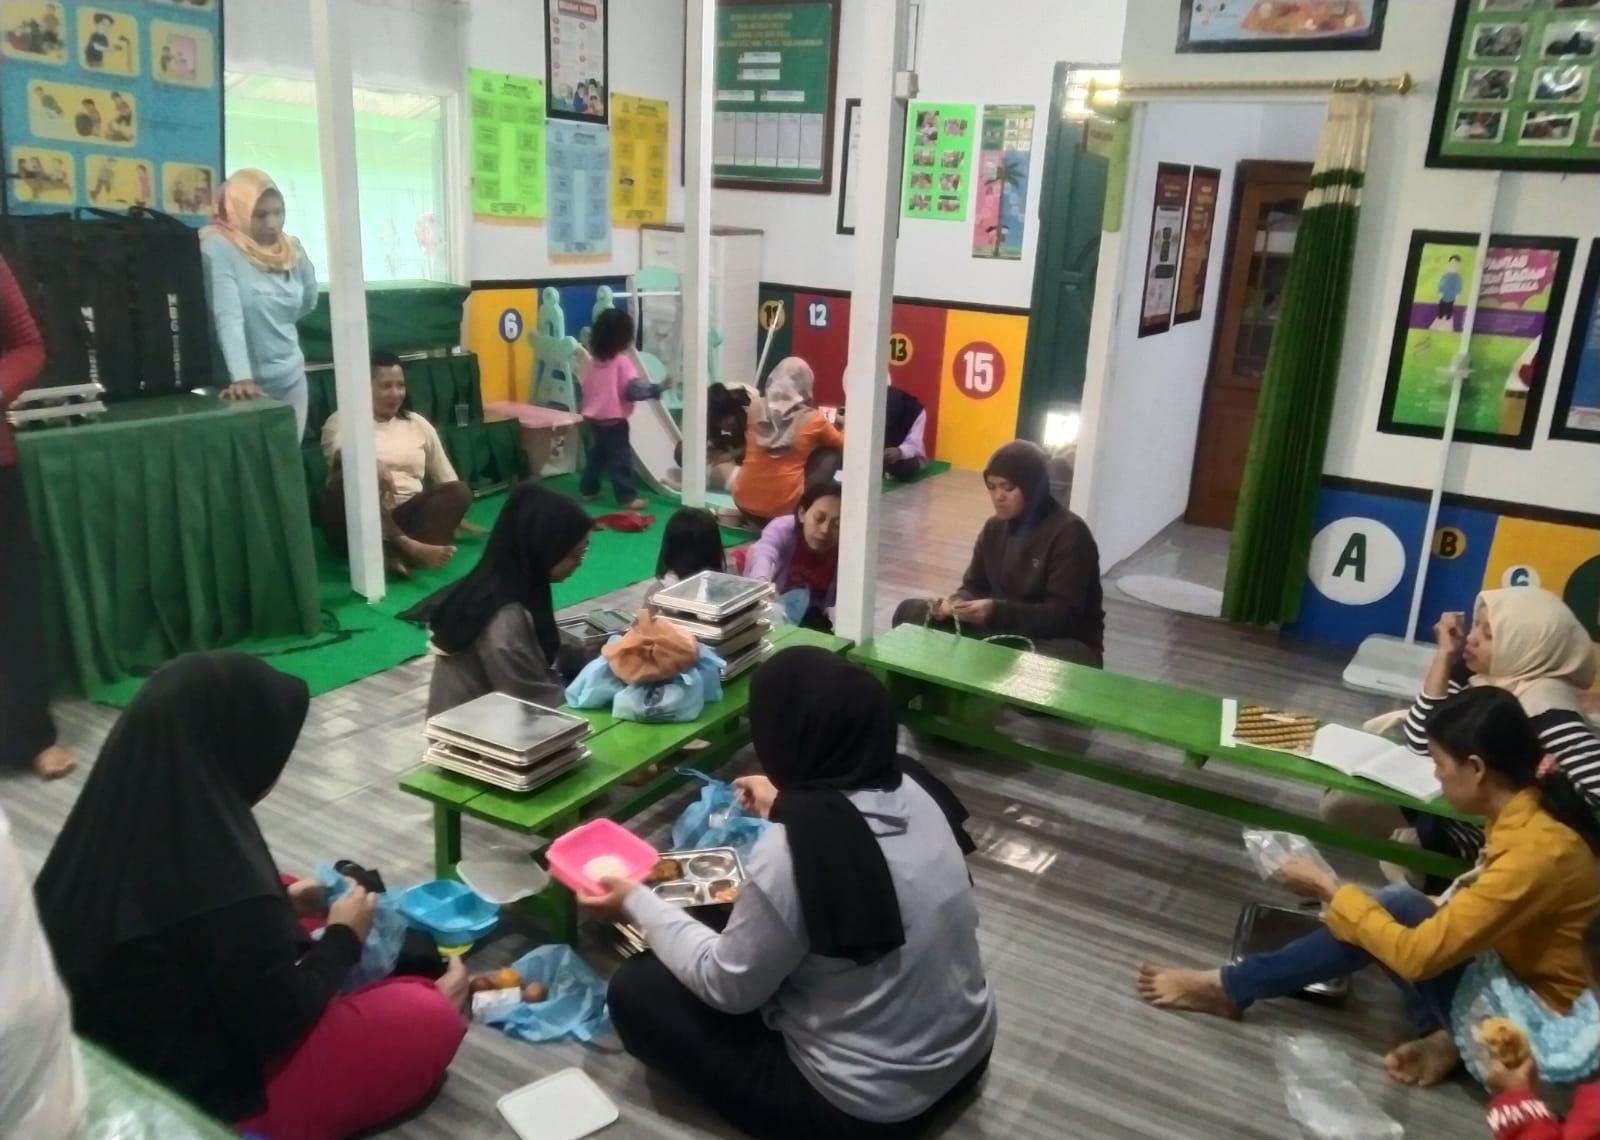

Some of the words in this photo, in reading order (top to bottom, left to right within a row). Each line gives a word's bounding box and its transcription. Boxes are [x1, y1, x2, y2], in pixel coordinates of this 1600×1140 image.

[504, 312, 519, 339] 6
[808, 303, 827, 327] 12
[889, 338, 908, 362] 13
[963, 350, 994, 393] 15
[1439, 531, 1458, 557] B
[1331, 532, 1367, 583] A
